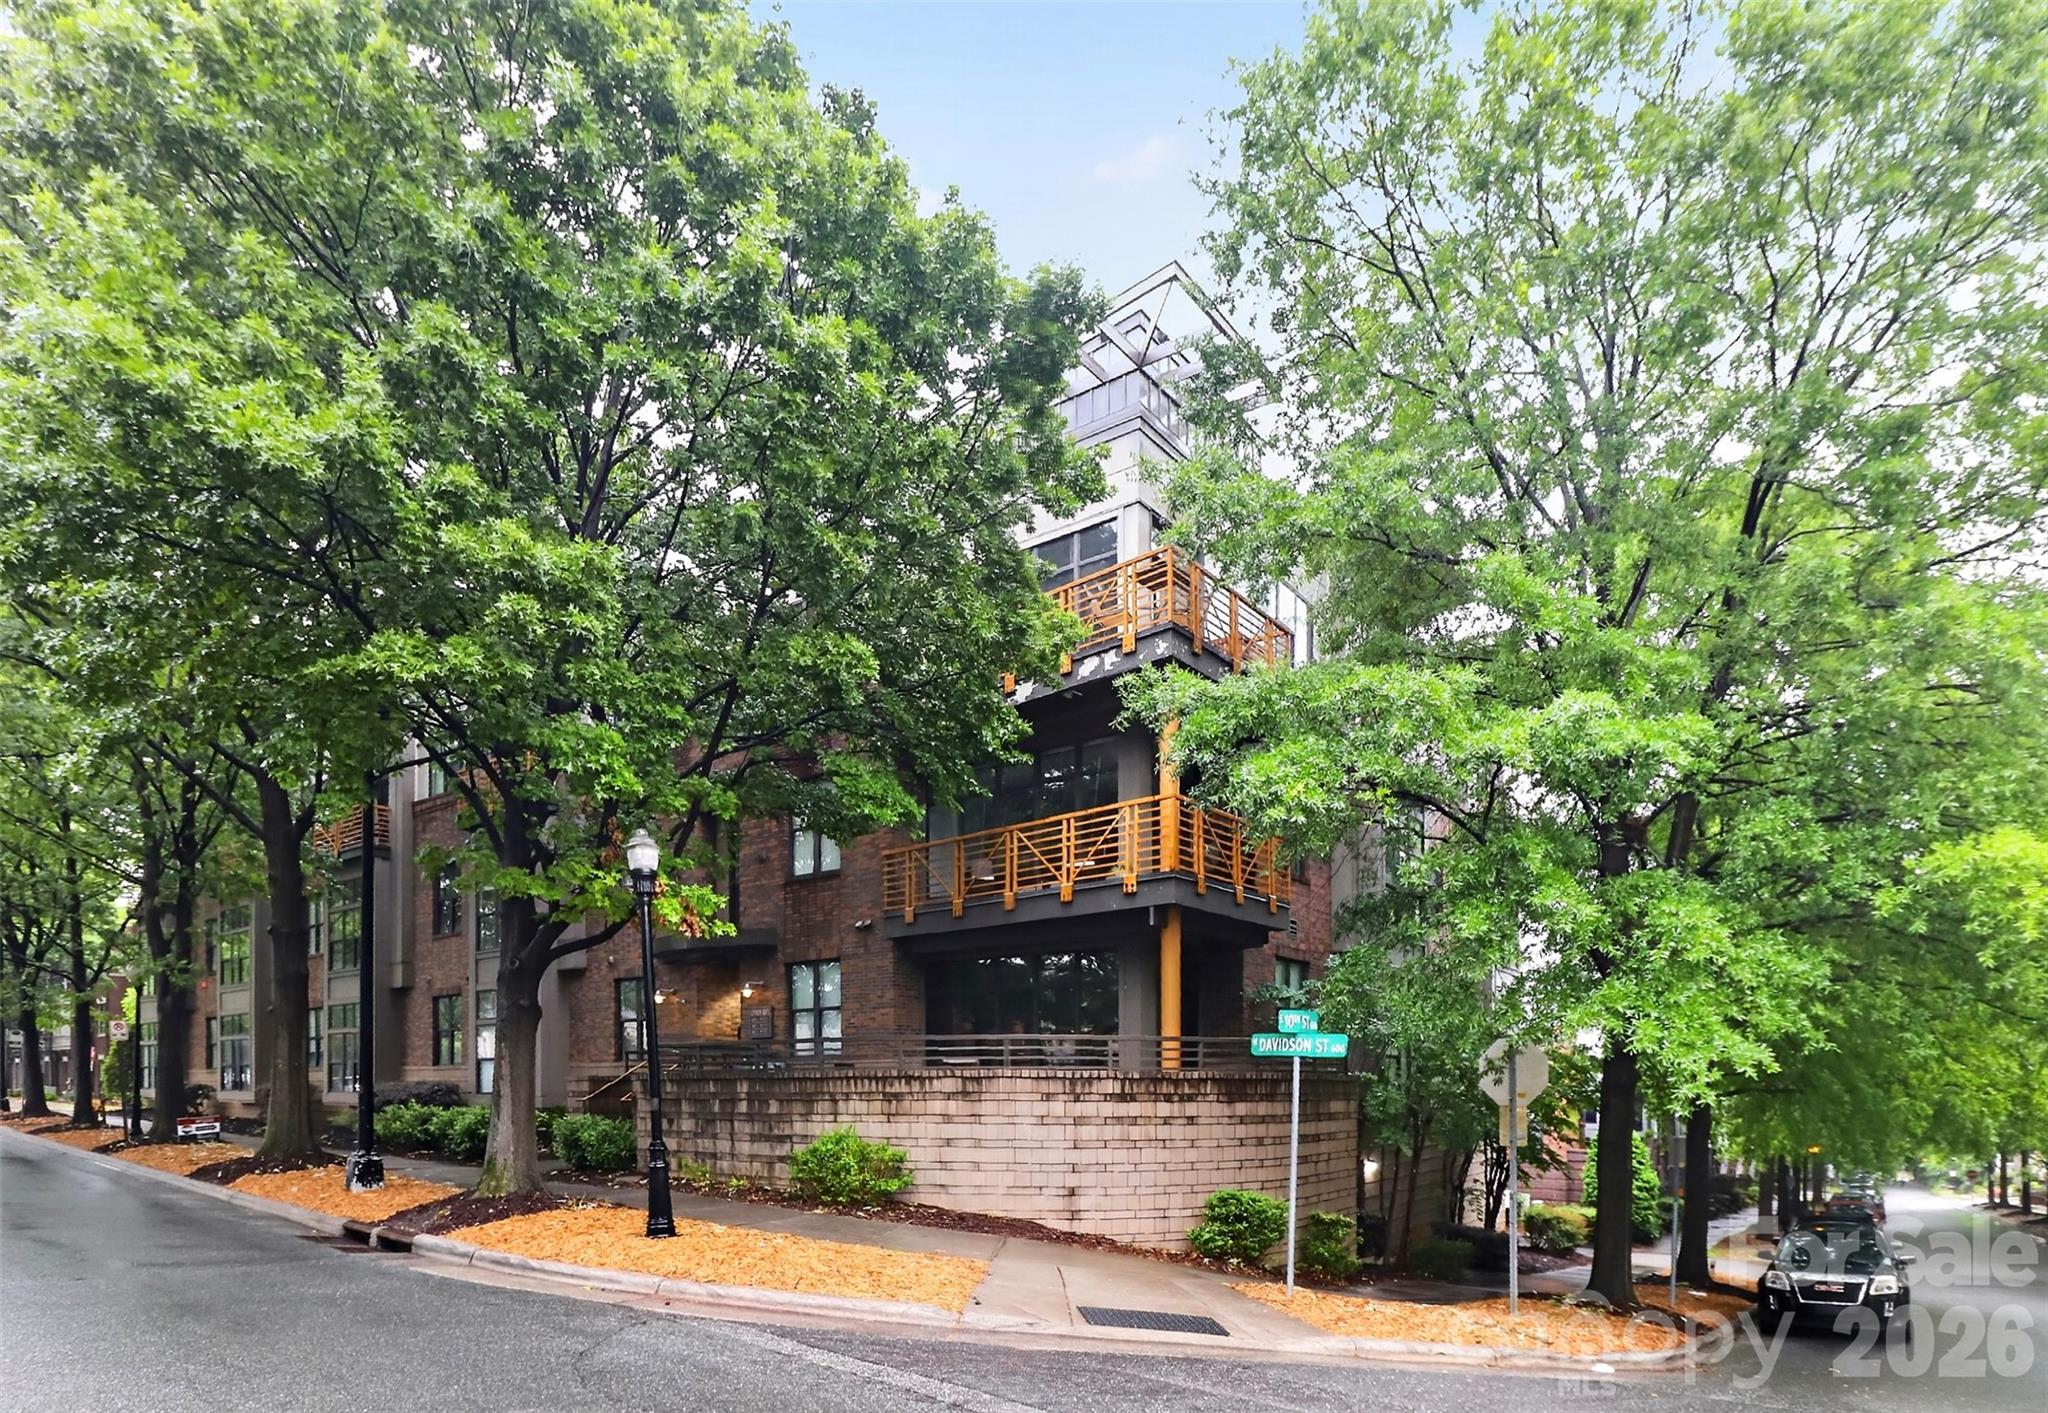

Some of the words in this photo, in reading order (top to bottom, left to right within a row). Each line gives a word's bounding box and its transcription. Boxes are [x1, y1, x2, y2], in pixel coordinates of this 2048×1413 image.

[1301, 1015, 1311, 1029] ST
[1259, 1037, 1312, 1053] DAVIDSON
[1315, 1038, 1329, 1053] ST
